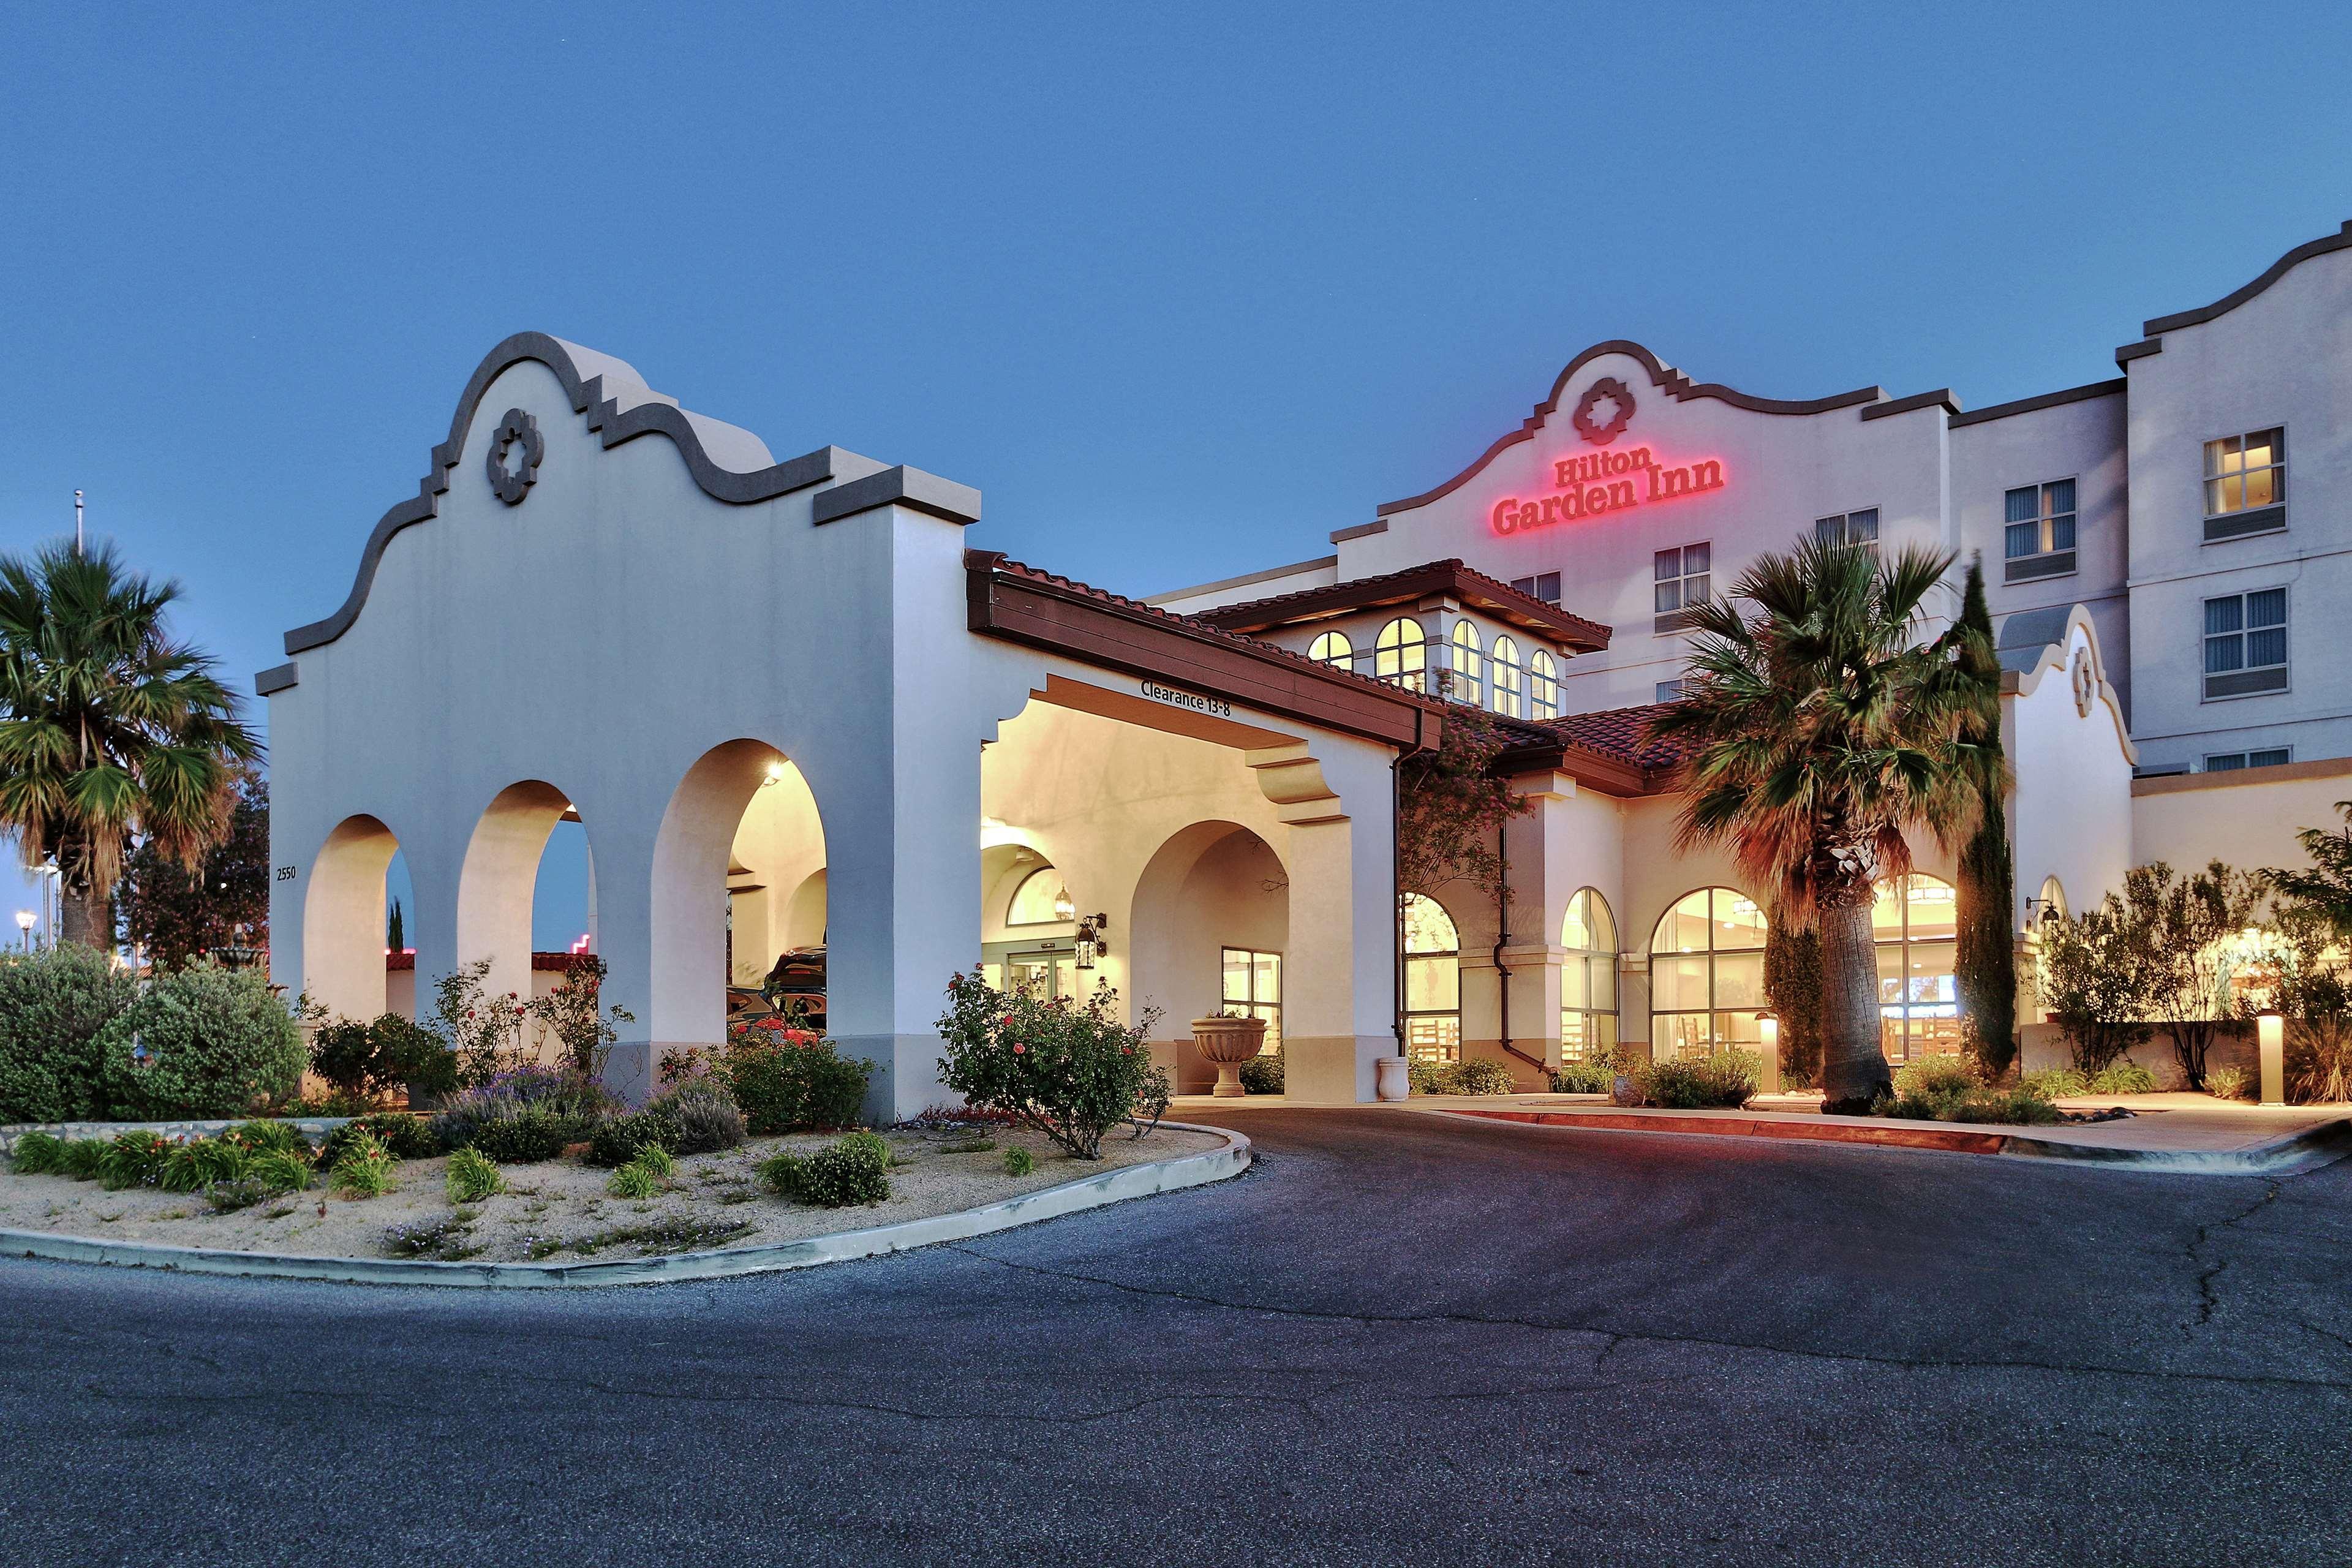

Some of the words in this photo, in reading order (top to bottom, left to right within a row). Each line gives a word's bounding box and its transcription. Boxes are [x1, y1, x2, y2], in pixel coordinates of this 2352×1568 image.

[1555, 447, 1653, 488] Hilton
[1493, 480, 1638, 535] Garden
[1646, 460, 1724, 502] Inn
[1141, 680, 1204, 710] Clearance
[1207, 697, 1231, 717] 13-8
[277, 865, 296, 881] 2550
